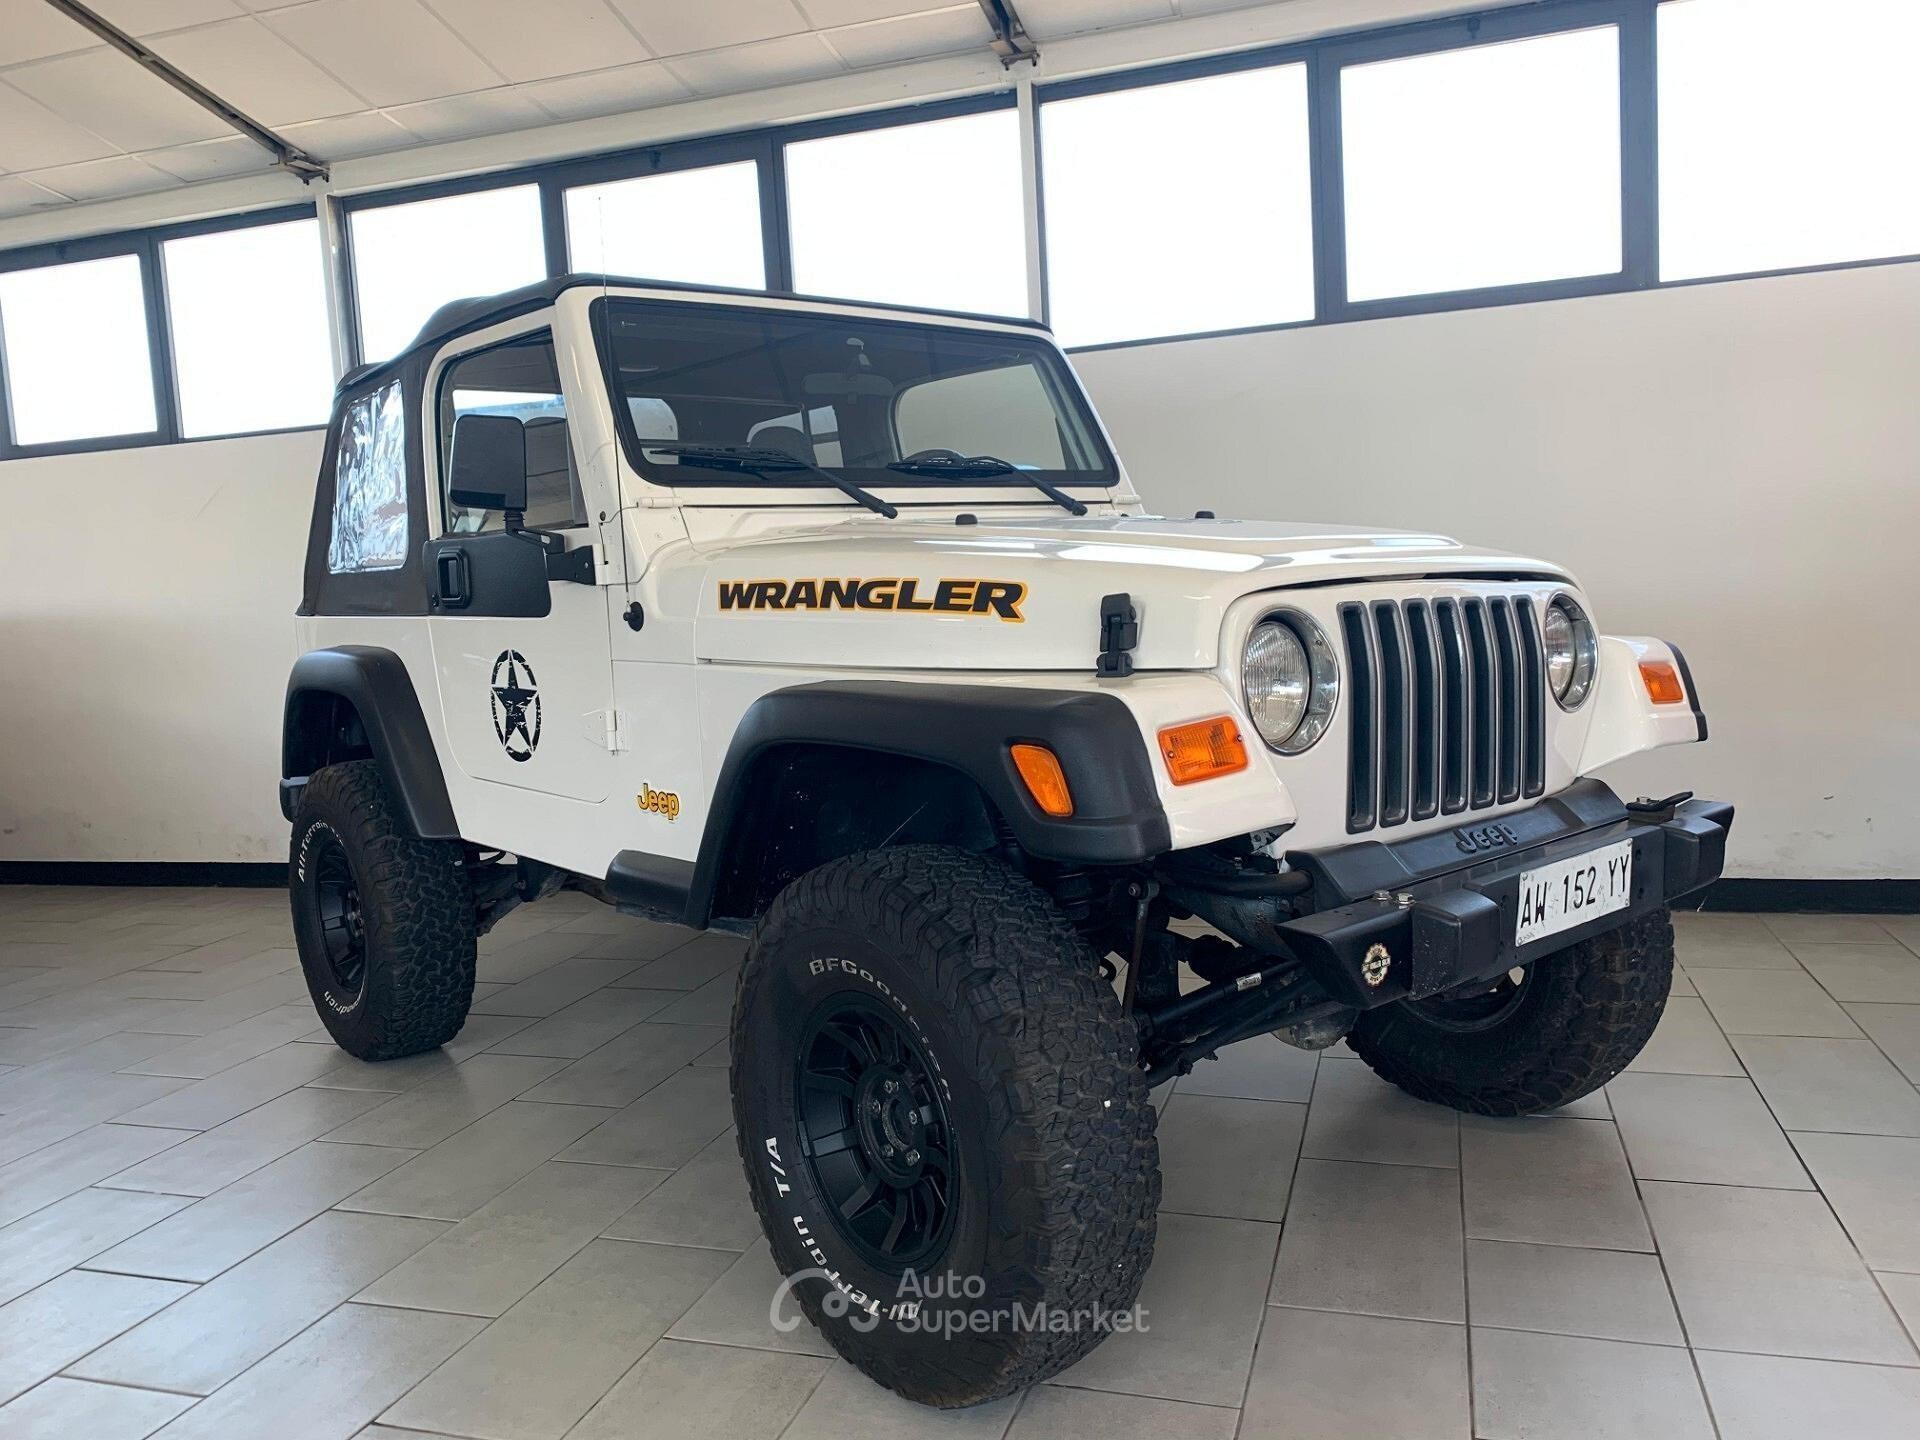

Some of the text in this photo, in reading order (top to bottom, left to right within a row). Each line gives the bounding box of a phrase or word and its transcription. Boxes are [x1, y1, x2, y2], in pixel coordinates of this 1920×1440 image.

[718, 577, 1029, 623] WRANGLER
[637, 782, 680, 821] Jeep
[1456, 824, 1518, 853] Jeep
[1520, 854, 1630, 929] AW 152 YY
[765, 1137, 792, 1198] T/A
